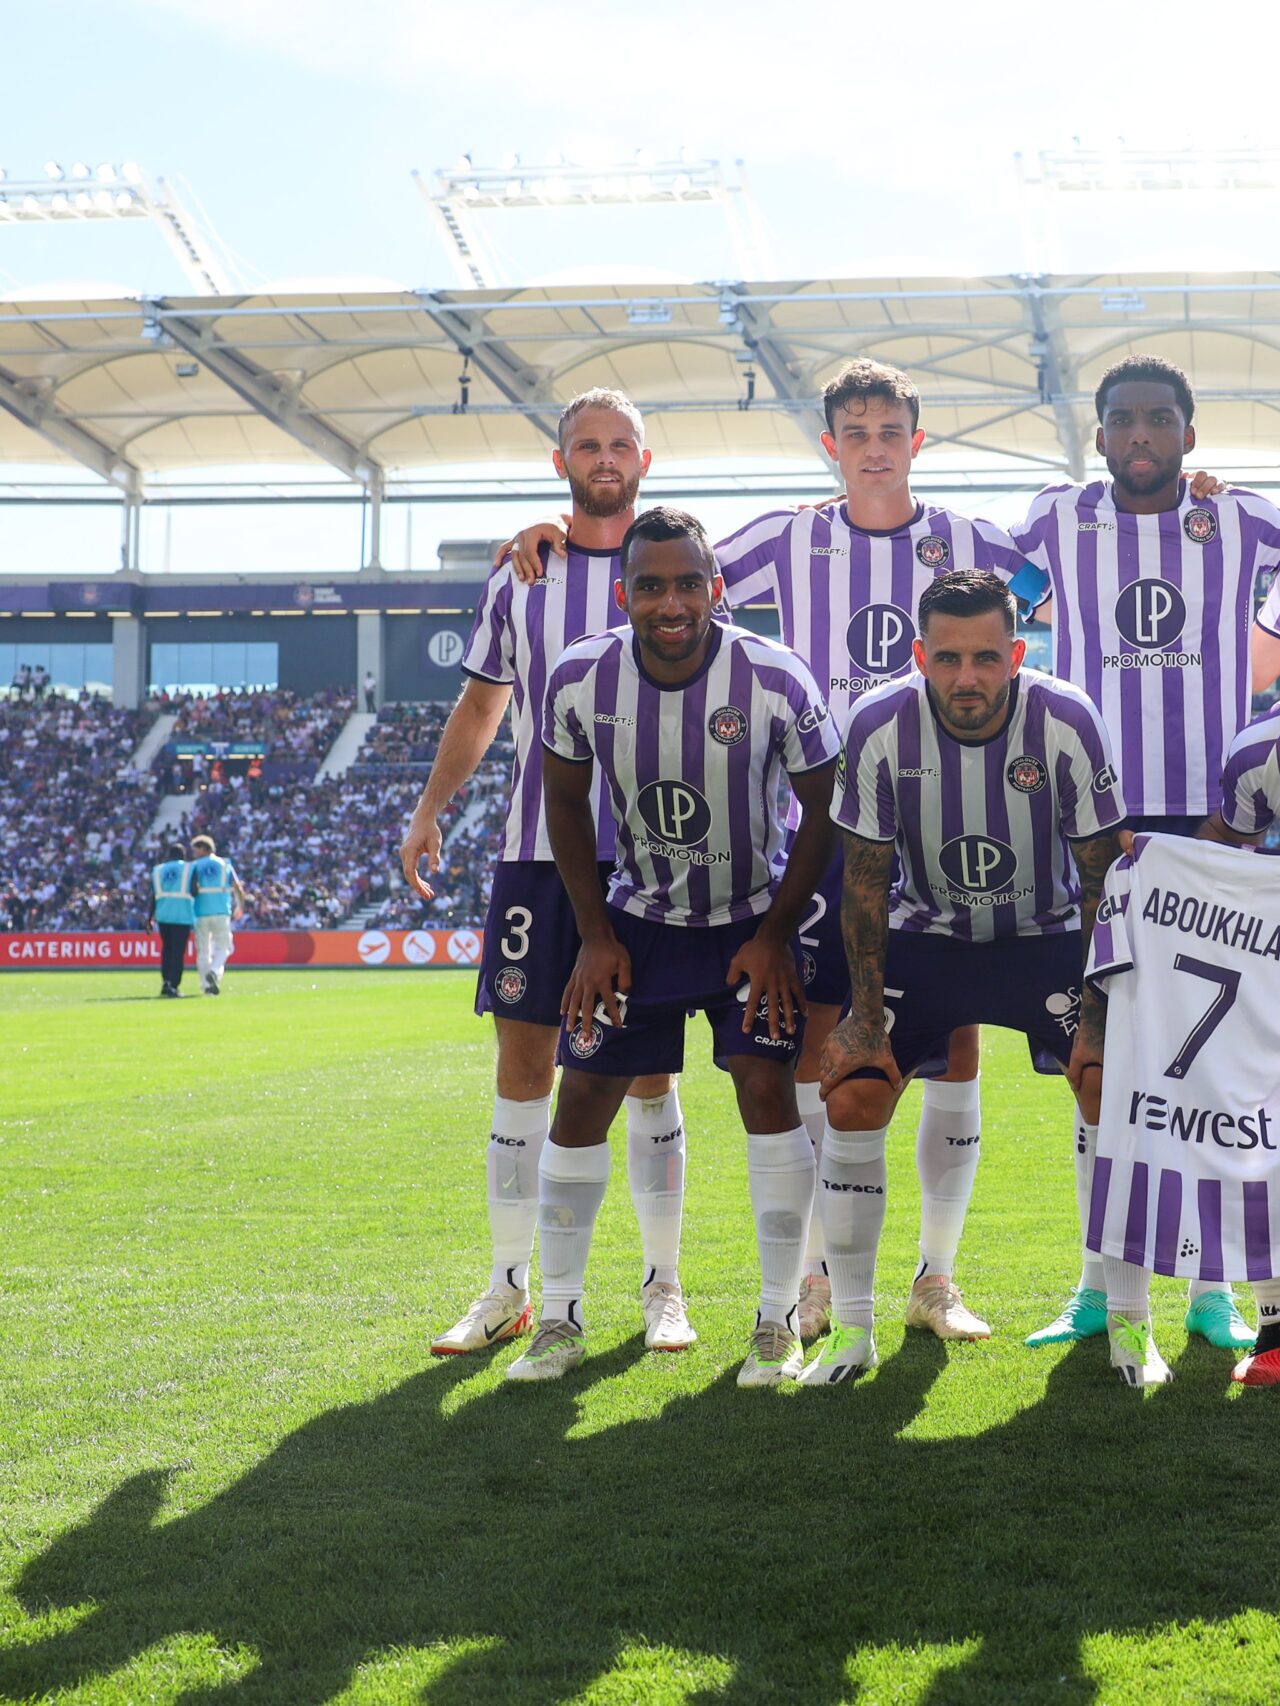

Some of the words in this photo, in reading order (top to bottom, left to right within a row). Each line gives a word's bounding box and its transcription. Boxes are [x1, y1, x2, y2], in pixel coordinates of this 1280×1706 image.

[1078, 522, 1107, 531] CRAFT
[811, 547, 840, 556] CRAFT
[1136, 585, 1173, 642] LP
[866, 610, 903, 667] LP
[1103, 652, 1201, 669] PROMOTION
[595, 714, 627, 725] CRAFT
[898, 768, 933, 778] CRAFT
[656, 785, 696, 840] LP
[632, 832, 732, 865] PROMOTION
[960, 840, 1001, 888] LP
[930, 883, 1035, 906] PROMOTION
[501, 905, 533, 961] 3
[8, 941, 111, 959] CATERING
[1163, 953, 1242, 1080] 7
[754, 1035, 790, 1049] CRAFT
